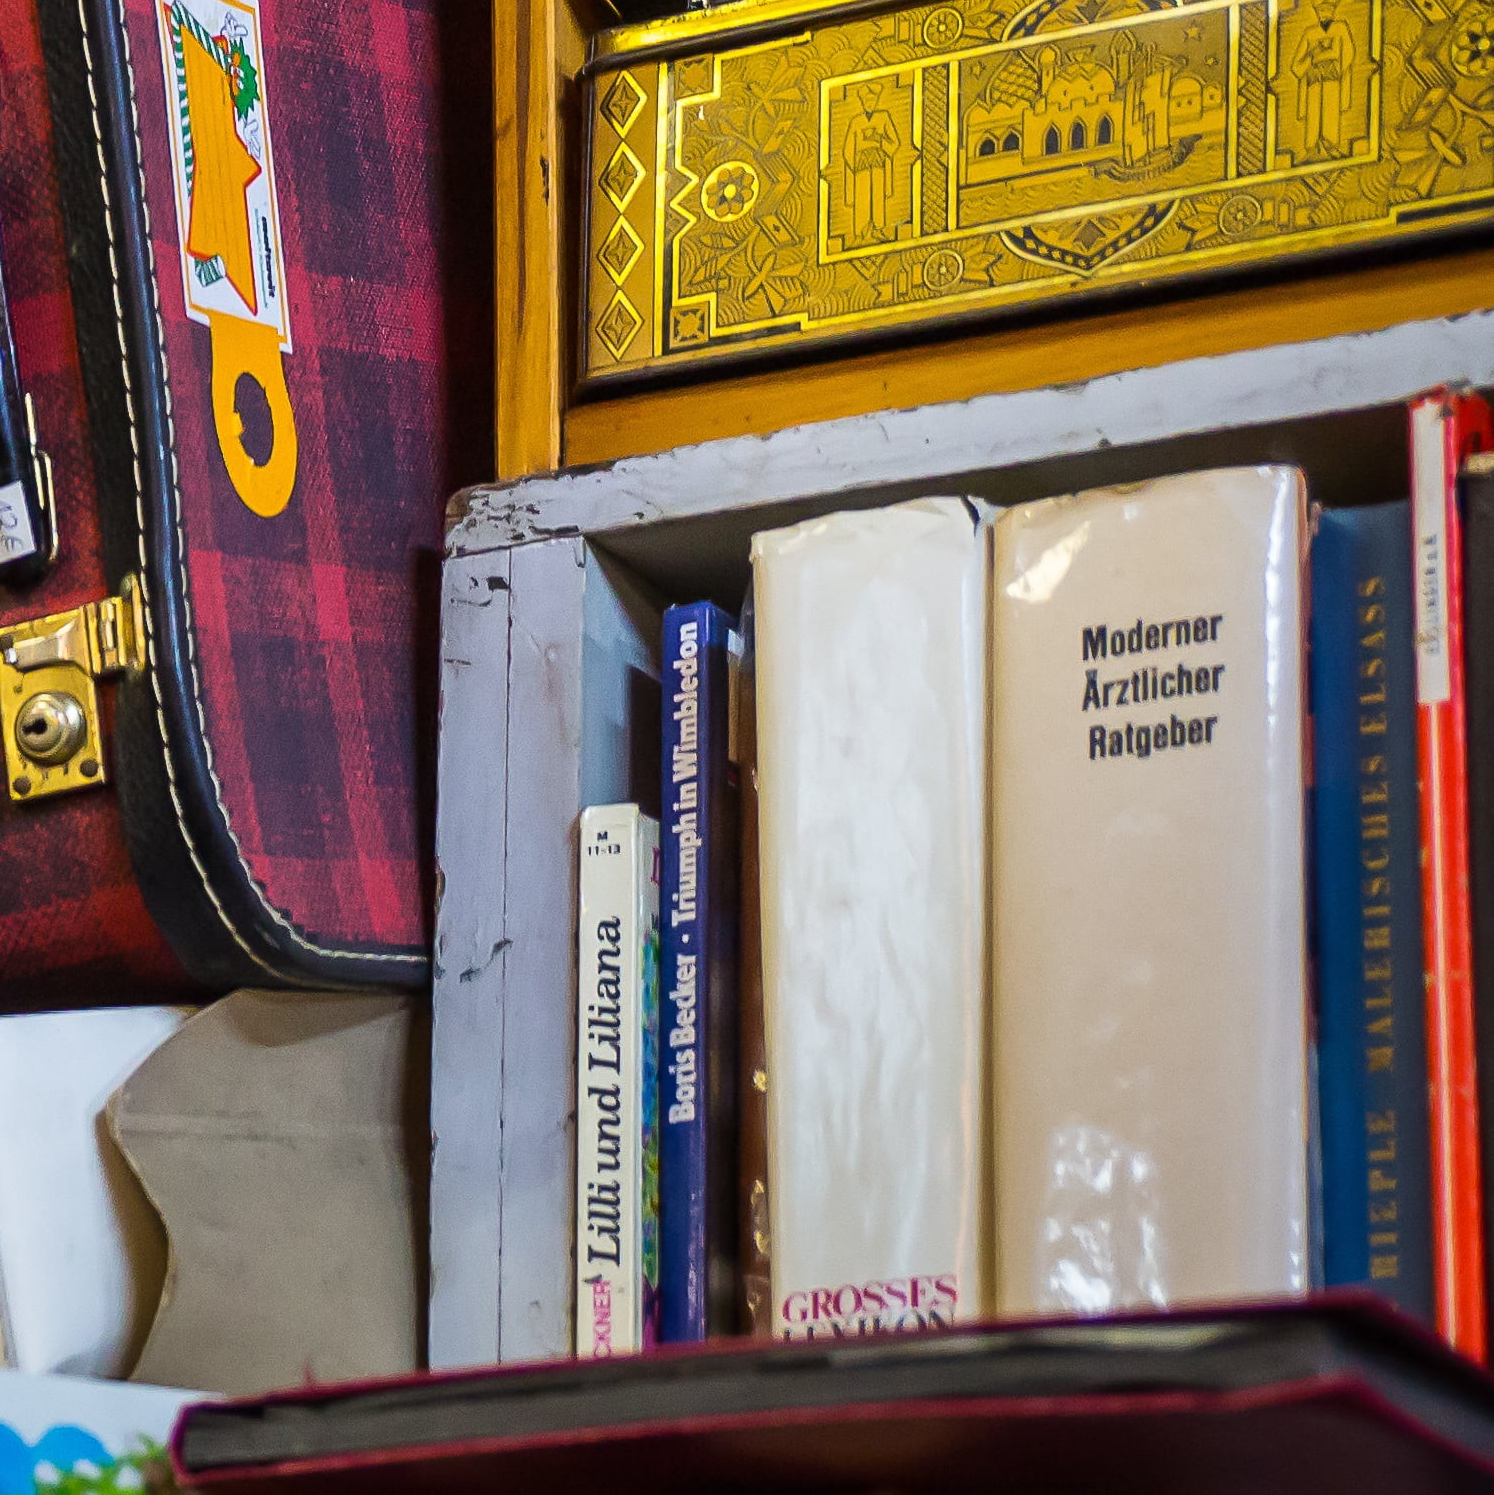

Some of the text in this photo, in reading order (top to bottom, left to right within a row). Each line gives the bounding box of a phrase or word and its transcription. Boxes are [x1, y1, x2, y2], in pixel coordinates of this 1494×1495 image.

[1082, 614, 1224, 661] Moderner
[1358, 575, 1389, 735] ELSASS
[1081, 663, 1225, 712] Ärztlicher
[1089, 713, 1218, 760] Ratgeber
[668, 621, 702, 1124] Boris Becker Triumph in Wimbledon
[586, 915, 622, 1268] Lilli und Liliana
[782, 1273, 958, 1324] GROSSES
